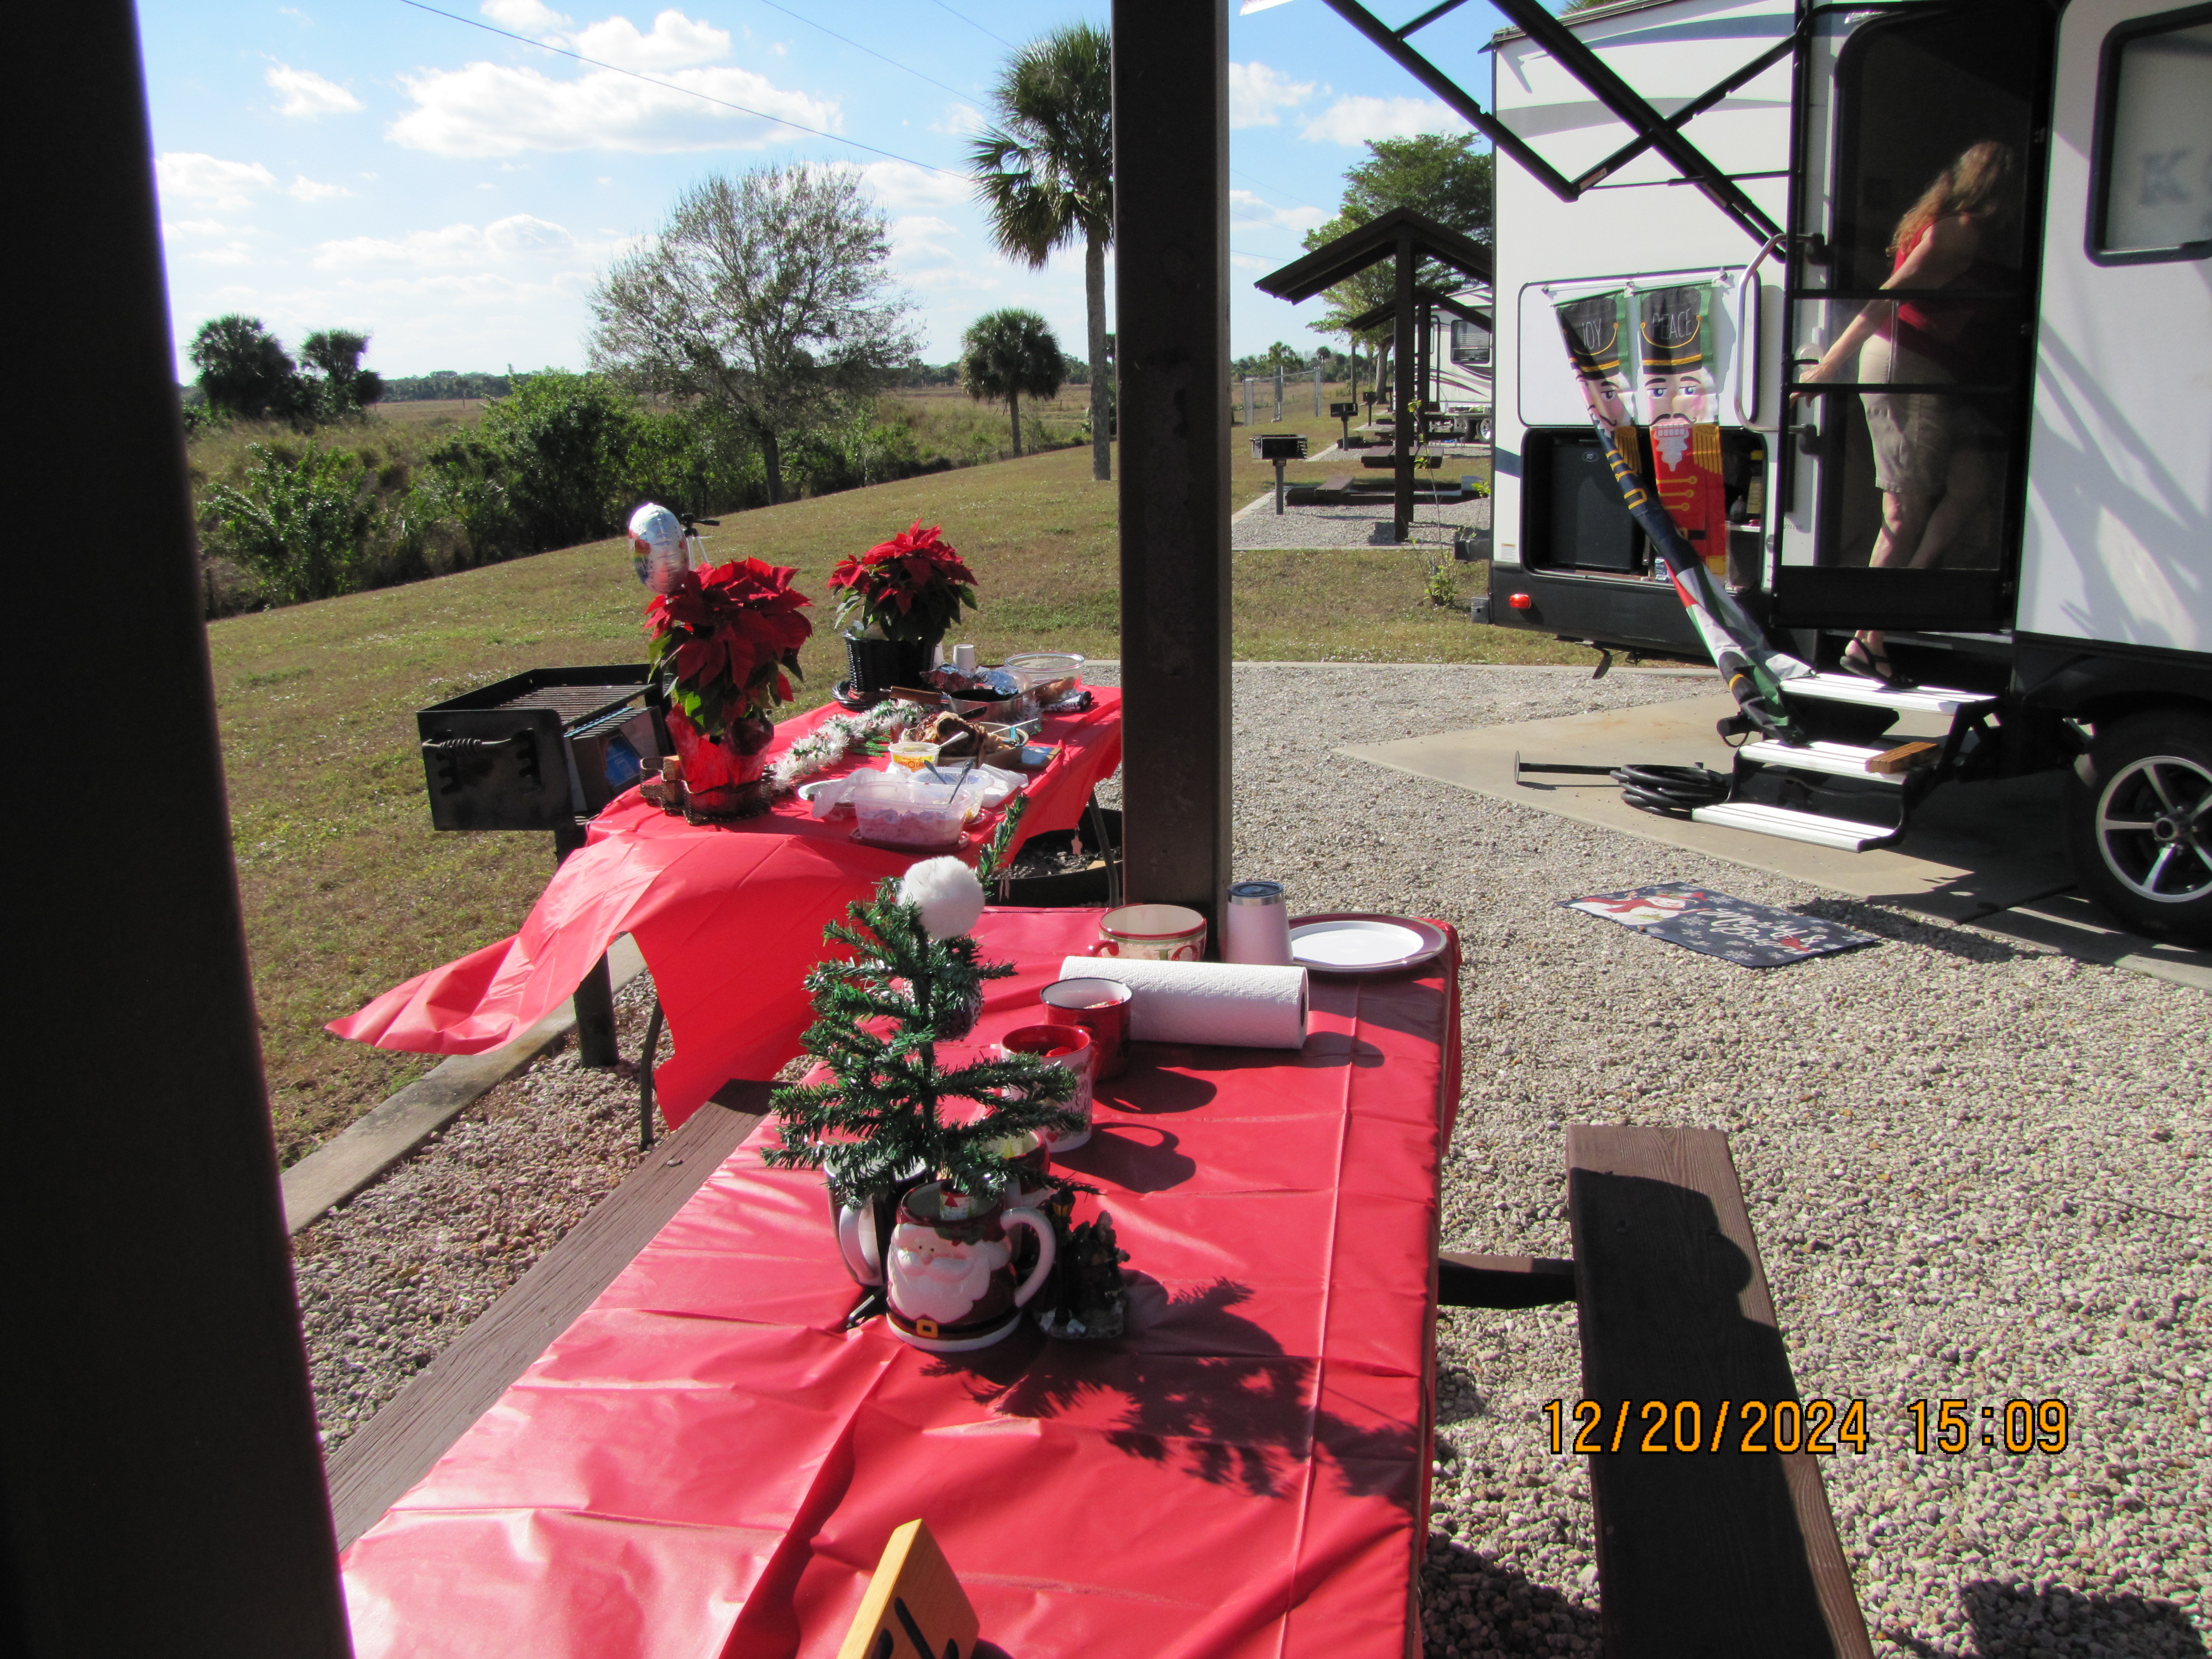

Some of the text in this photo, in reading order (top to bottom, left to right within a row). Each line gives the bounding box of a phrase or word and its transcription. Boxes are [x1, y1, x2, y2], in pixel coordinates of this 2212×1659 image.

[1581, 318, 1601, 349] JOY
[1652, 308, 1692, 340] PEACE
[1697, 908, 1827, 945] Merry &
